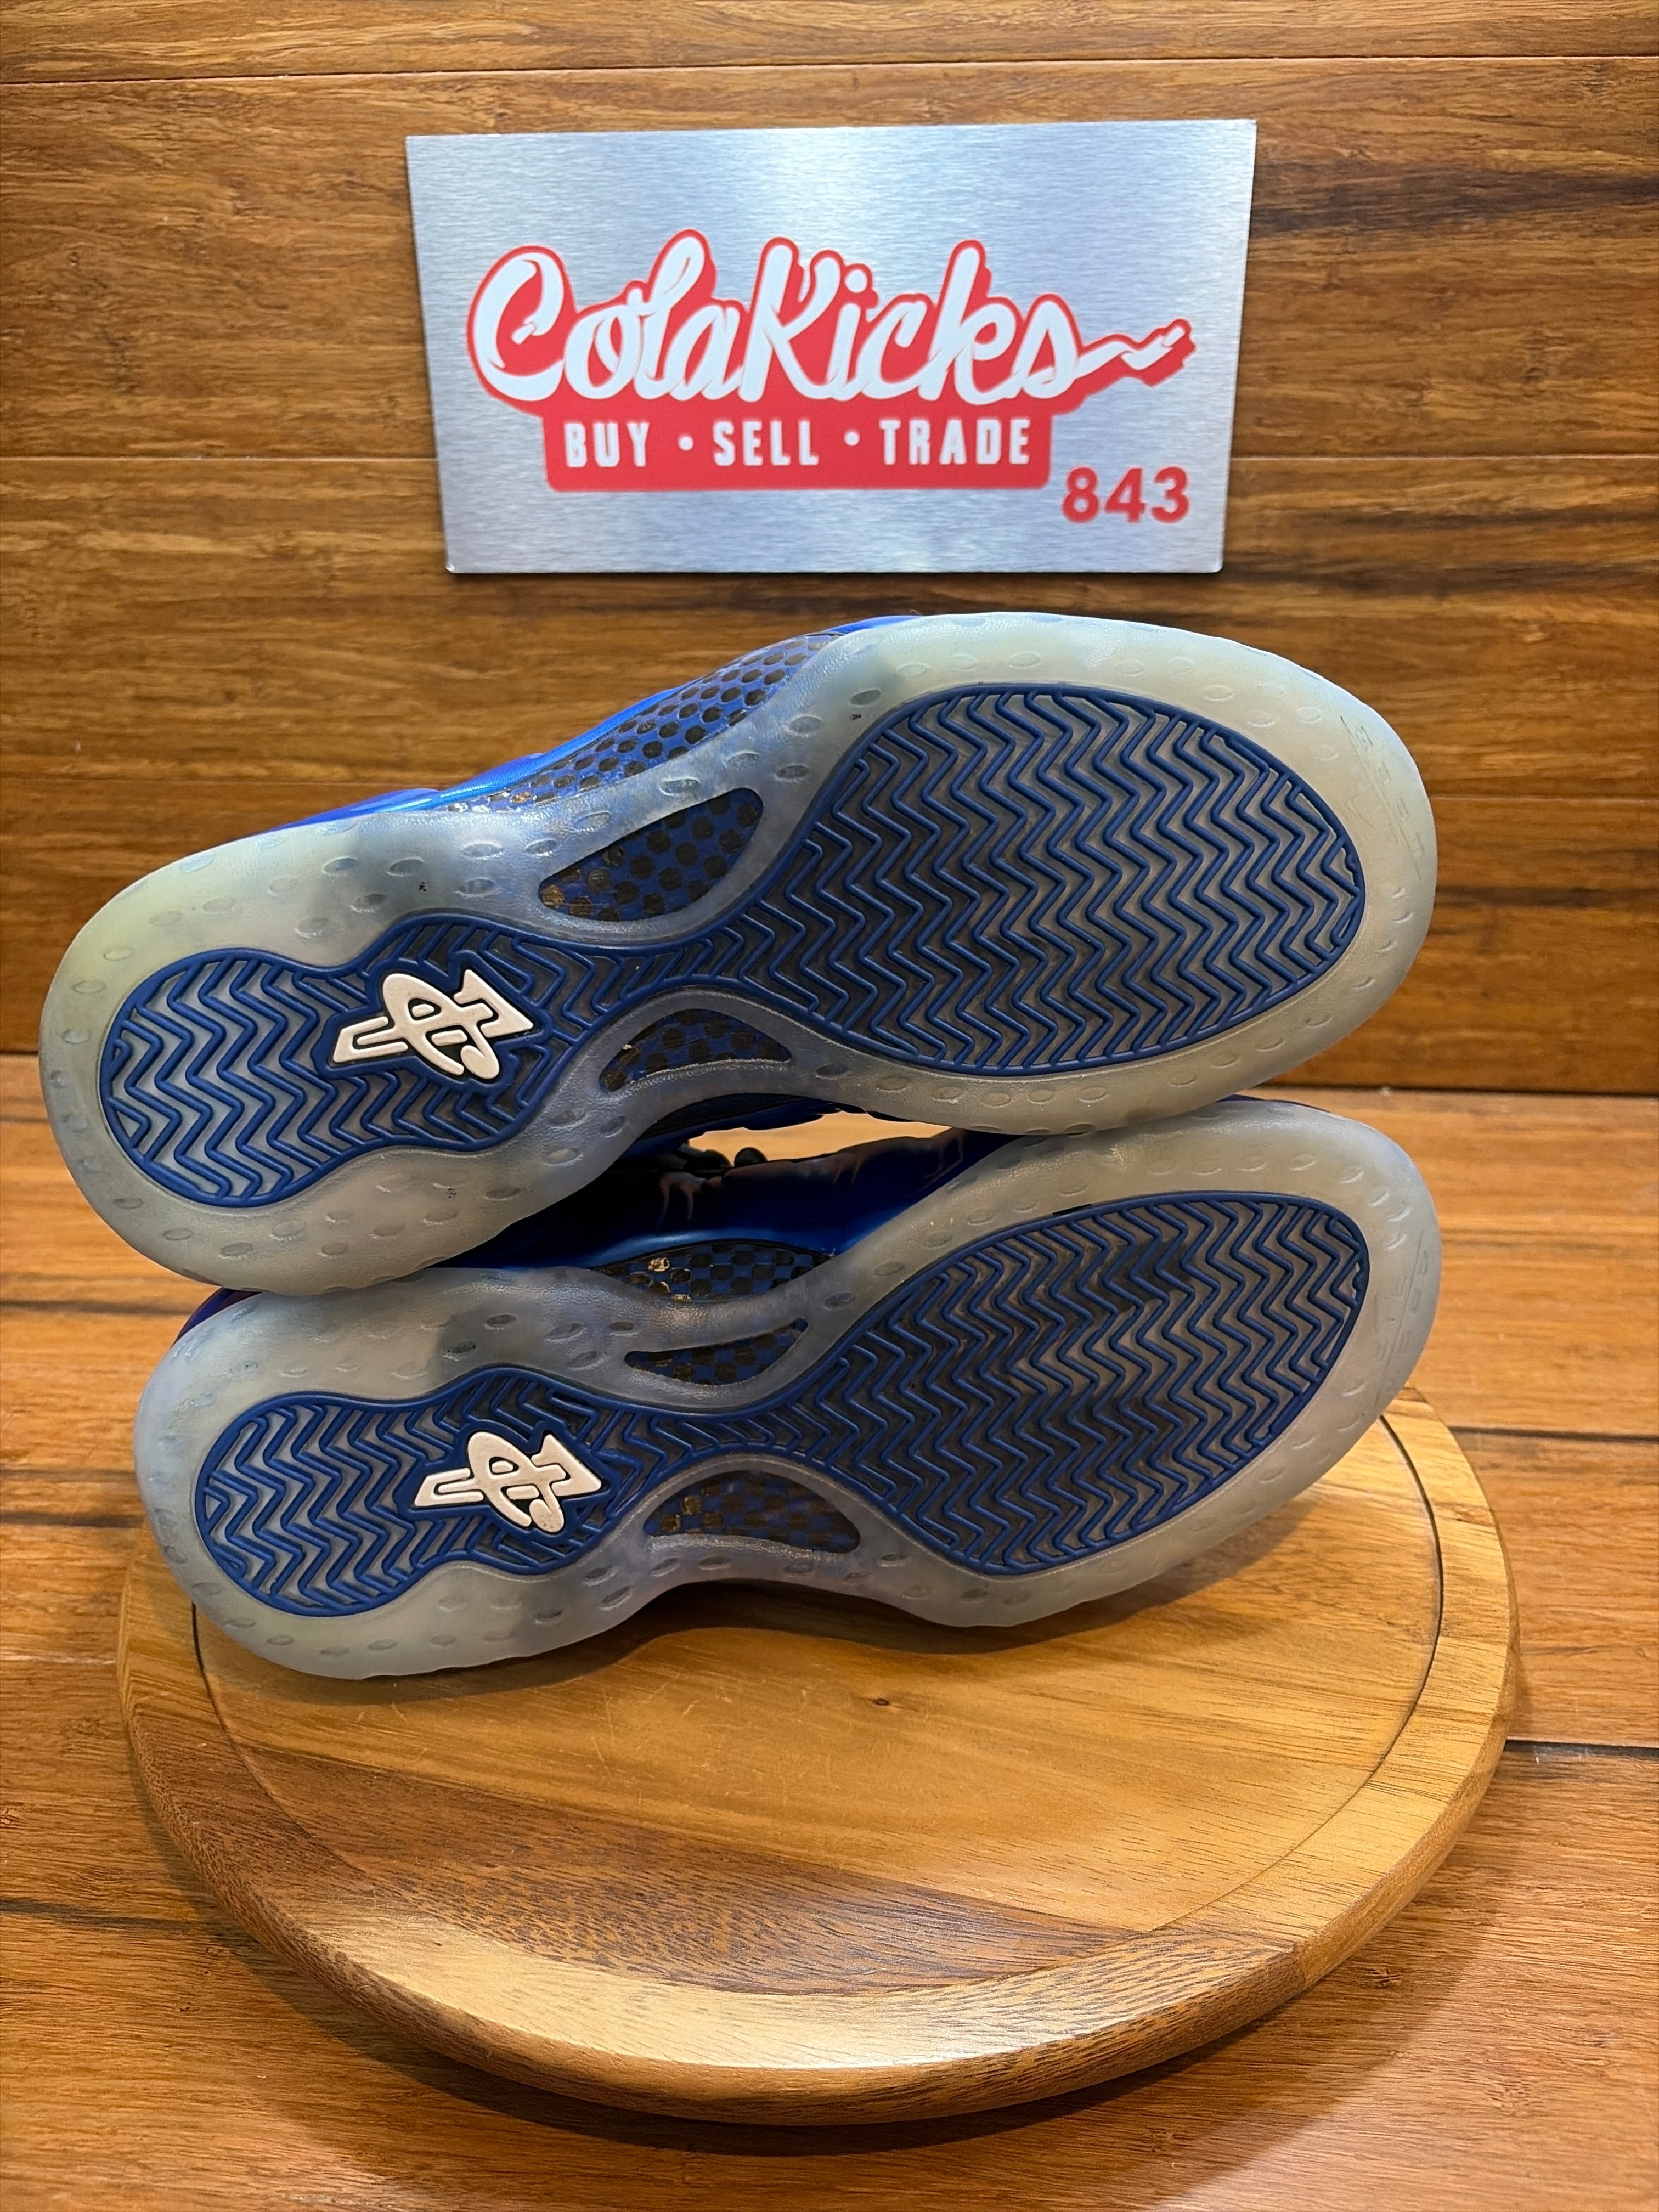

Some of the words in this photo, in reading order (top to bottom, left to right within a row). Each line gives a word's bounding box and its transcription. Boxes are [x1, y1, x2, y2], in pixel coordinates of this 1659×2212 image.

[472, 233, 1190, 405] ColaKicks
[563, 420, 651, 469] BUY
[713, 419, 820, 467] SELL
[879, 416, 1030, 466] TRADE
[1062, 466, 1189, 523] 843
